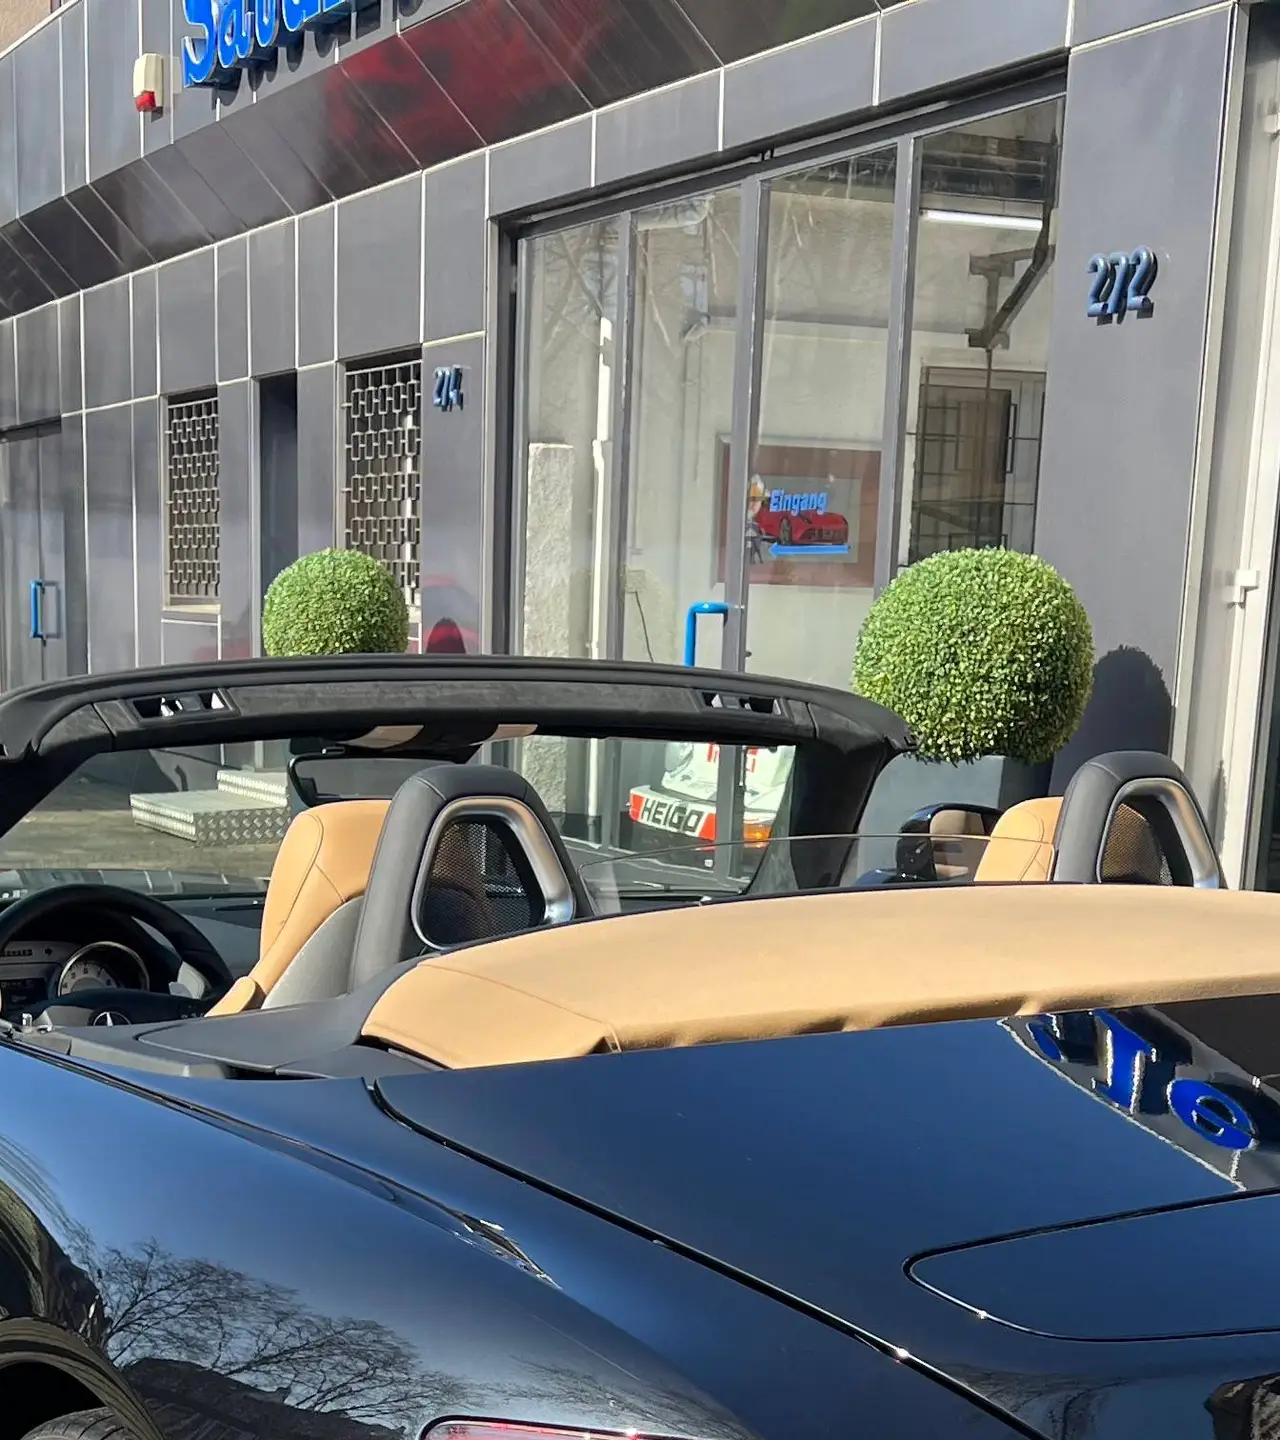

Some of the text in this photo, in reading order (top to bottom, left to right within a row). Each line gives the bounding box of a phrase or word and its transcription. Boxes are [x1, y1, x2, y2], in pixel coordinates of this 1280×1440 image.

[1086, 246, 1154, 318] 272
[768, 488, 828, 517] Eingang
[641, 797, 705, 833] HEIGO
